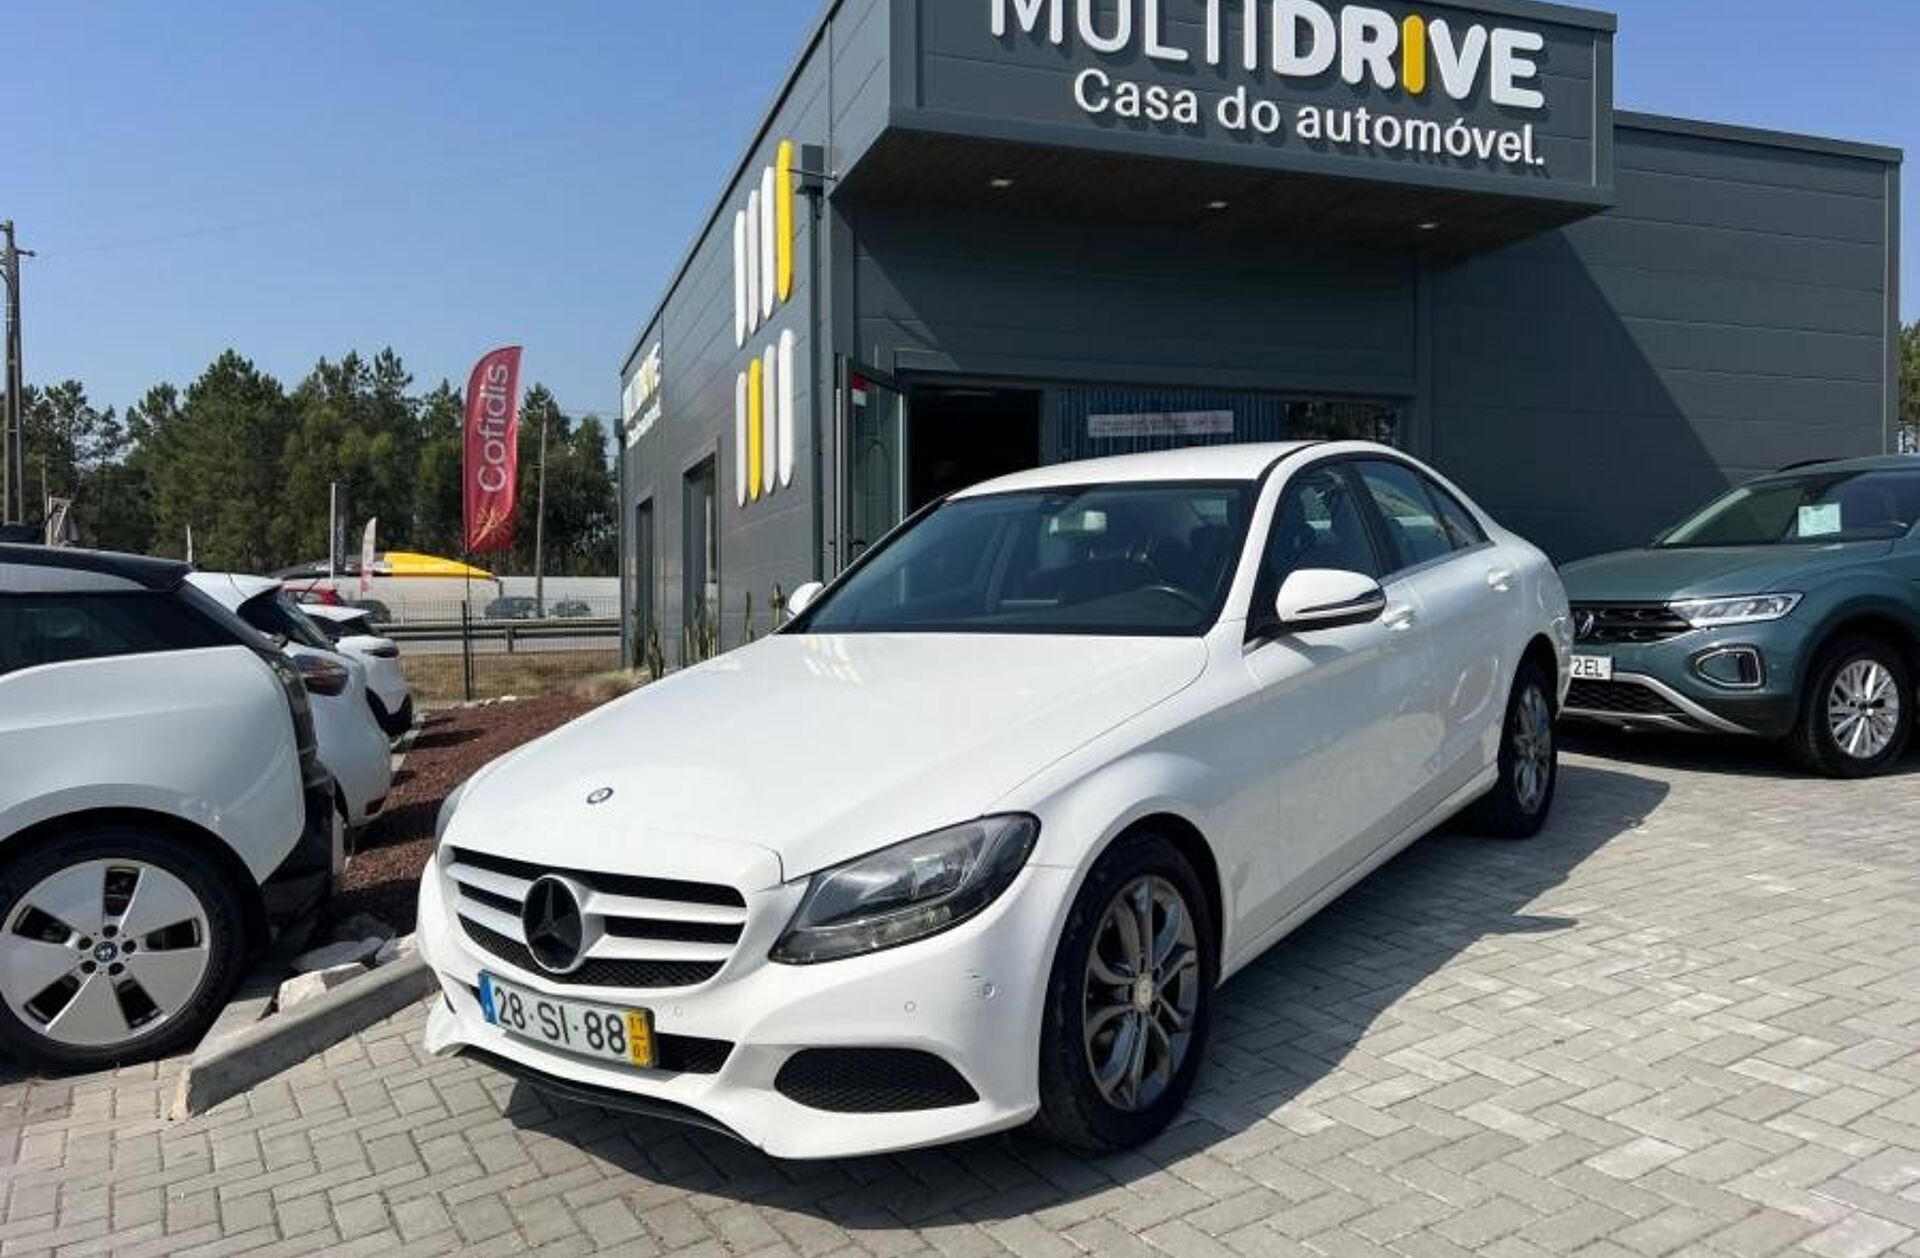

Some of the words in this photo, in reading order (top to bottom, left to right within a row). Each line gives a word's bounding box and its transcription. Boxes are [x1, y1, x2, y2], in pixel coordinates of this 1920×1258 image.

[1074, 68, 1198, 124] Casa
[1217, 86, 1280, 133] do
[1296, 105, 1545, 166] automóvel.
[477, 364, 509, 492] Cofidis
